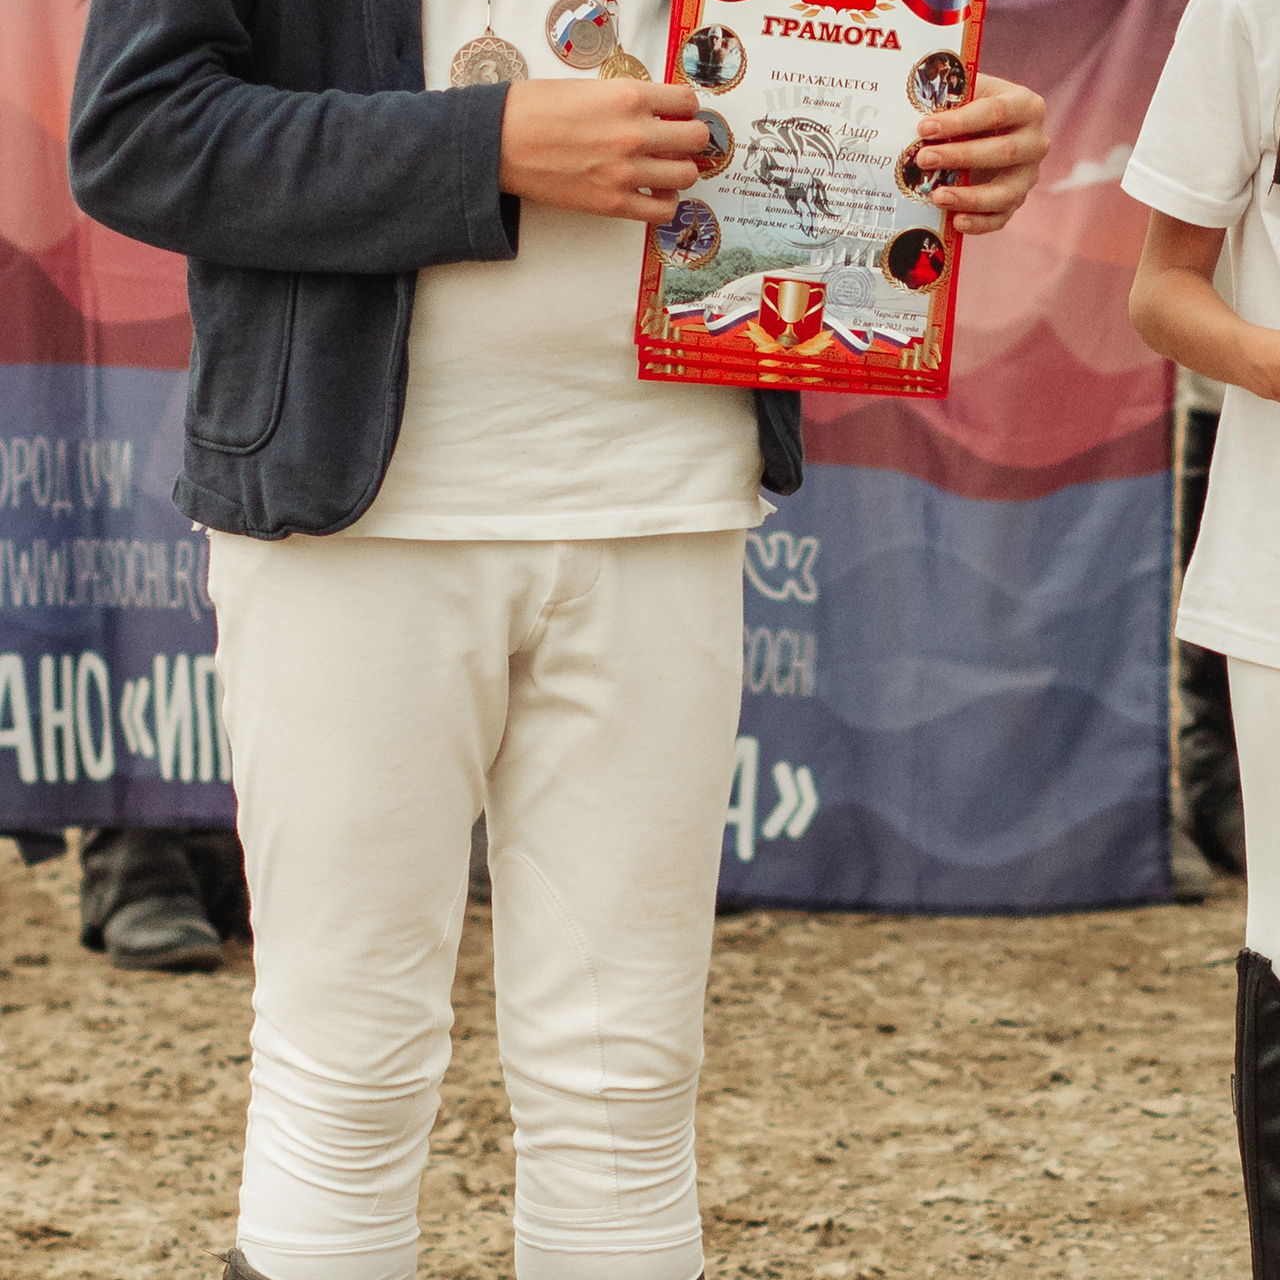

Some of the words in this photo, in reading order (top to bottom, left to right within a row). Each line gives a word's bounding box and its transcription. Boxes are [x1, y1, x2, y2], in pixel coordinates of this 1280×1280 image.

[761, 15, 902, 51] ГРАМОТА
[771, 70, 879, 91] НАГРАЖДАЕТСЯ
[802, 96, 842, 108] Всадник
[835, 123, 879, 142] Амир
[836, 147, 893, 169] Батыр
[826, 171, 858, 180] место
[718, 185, 730, 194] по
[737, 216, 789, 230] программе
[0, 650, 117, 784] АНО
